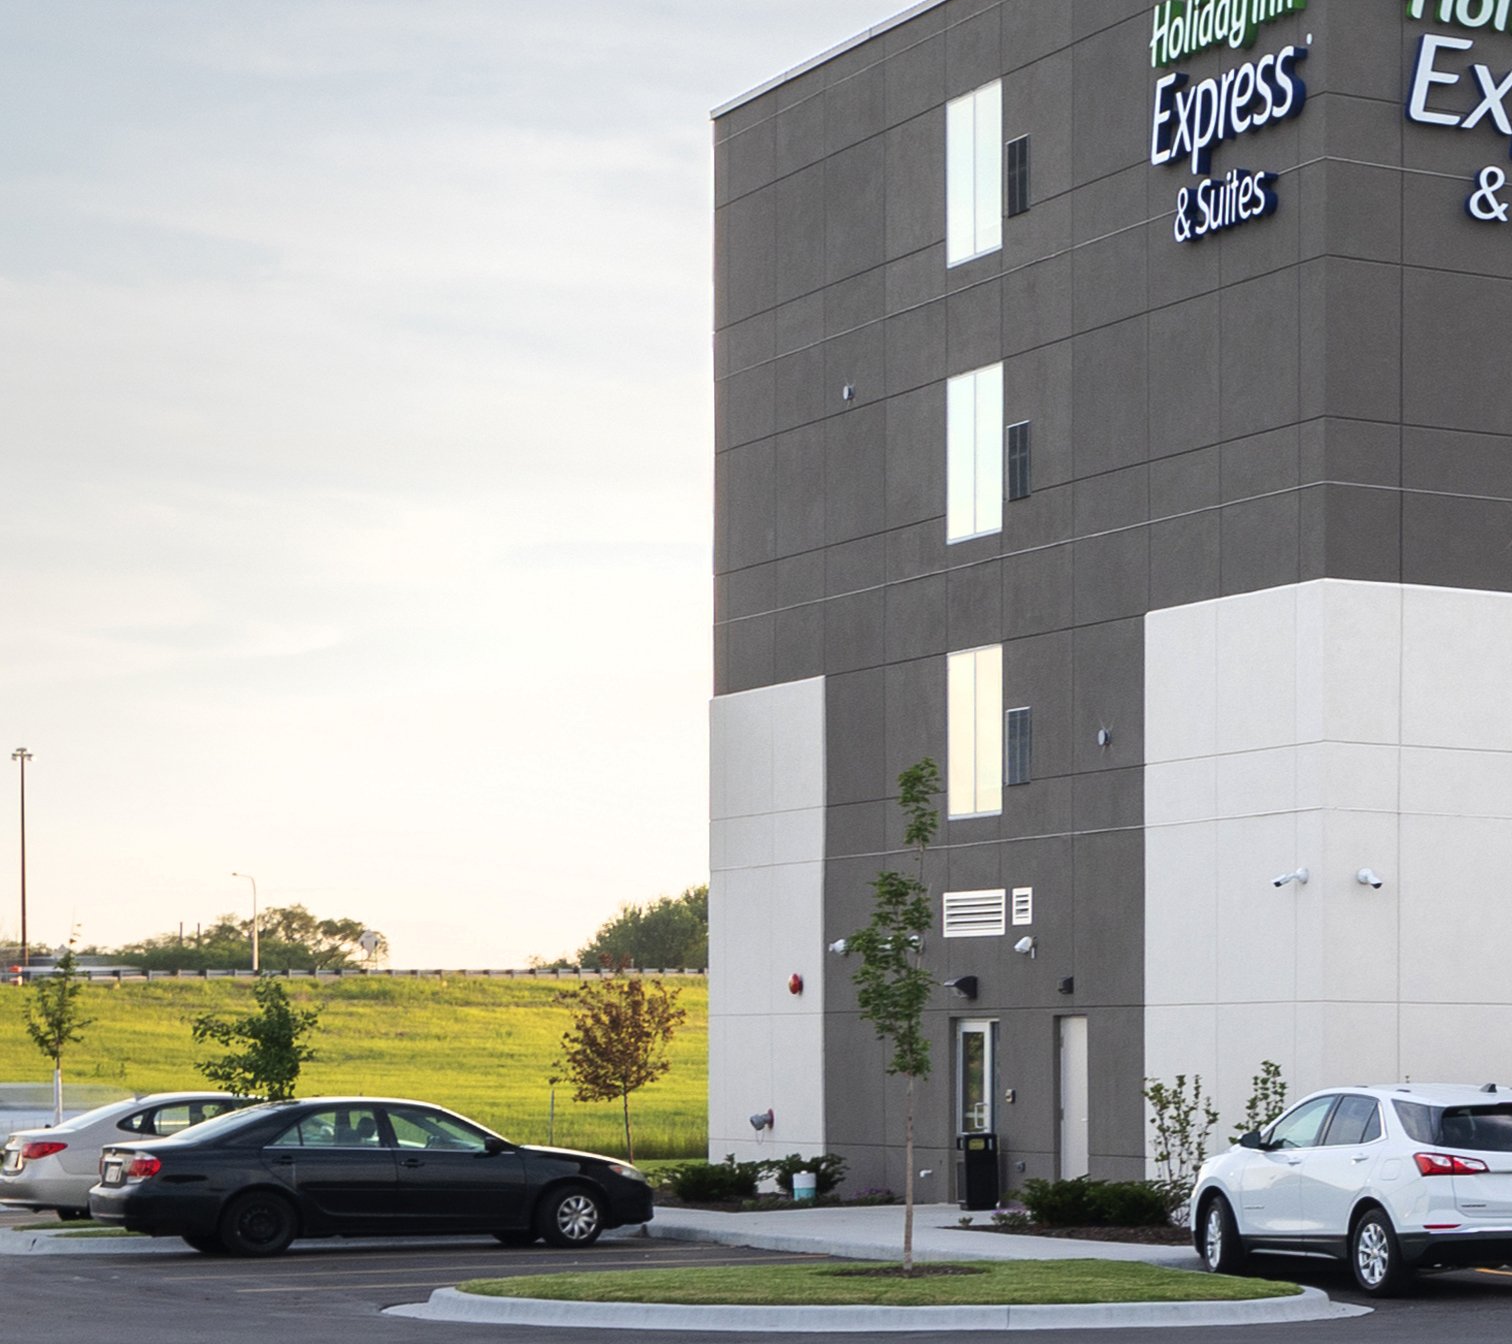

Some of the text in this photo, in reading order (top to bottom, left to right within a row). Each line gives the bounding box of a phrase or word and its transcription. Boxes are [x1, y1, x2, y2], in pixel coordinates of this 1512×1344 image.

[1152, 45, 1295, 175] Express
[1174, 168, 1265, 242] & Suites
[1468, 166, 1509, 222] &
